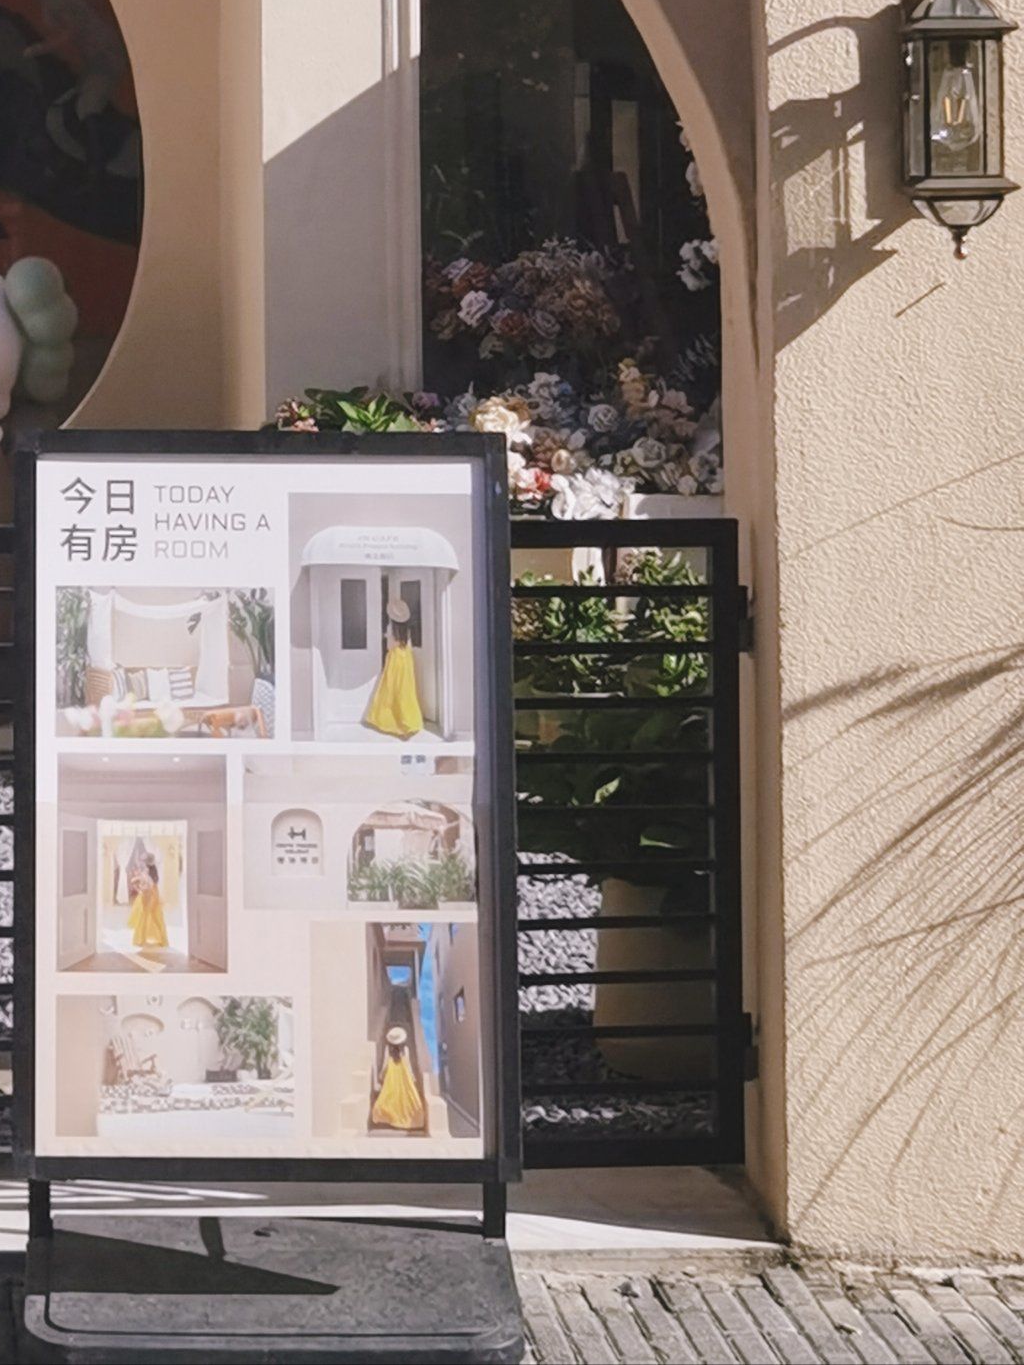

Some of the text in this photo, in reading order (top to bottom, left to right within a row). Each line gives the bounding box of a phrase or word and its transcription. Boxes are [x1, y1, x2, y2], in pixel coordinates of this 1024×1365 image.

[60, 476, 135, 515] 今日
[154, 485, 235, 504] TODAY
[154, 513, 271, 531] HAVING A
[60, 523, 138, 562] 有房
[154, 540, 229, 559] ROOM
